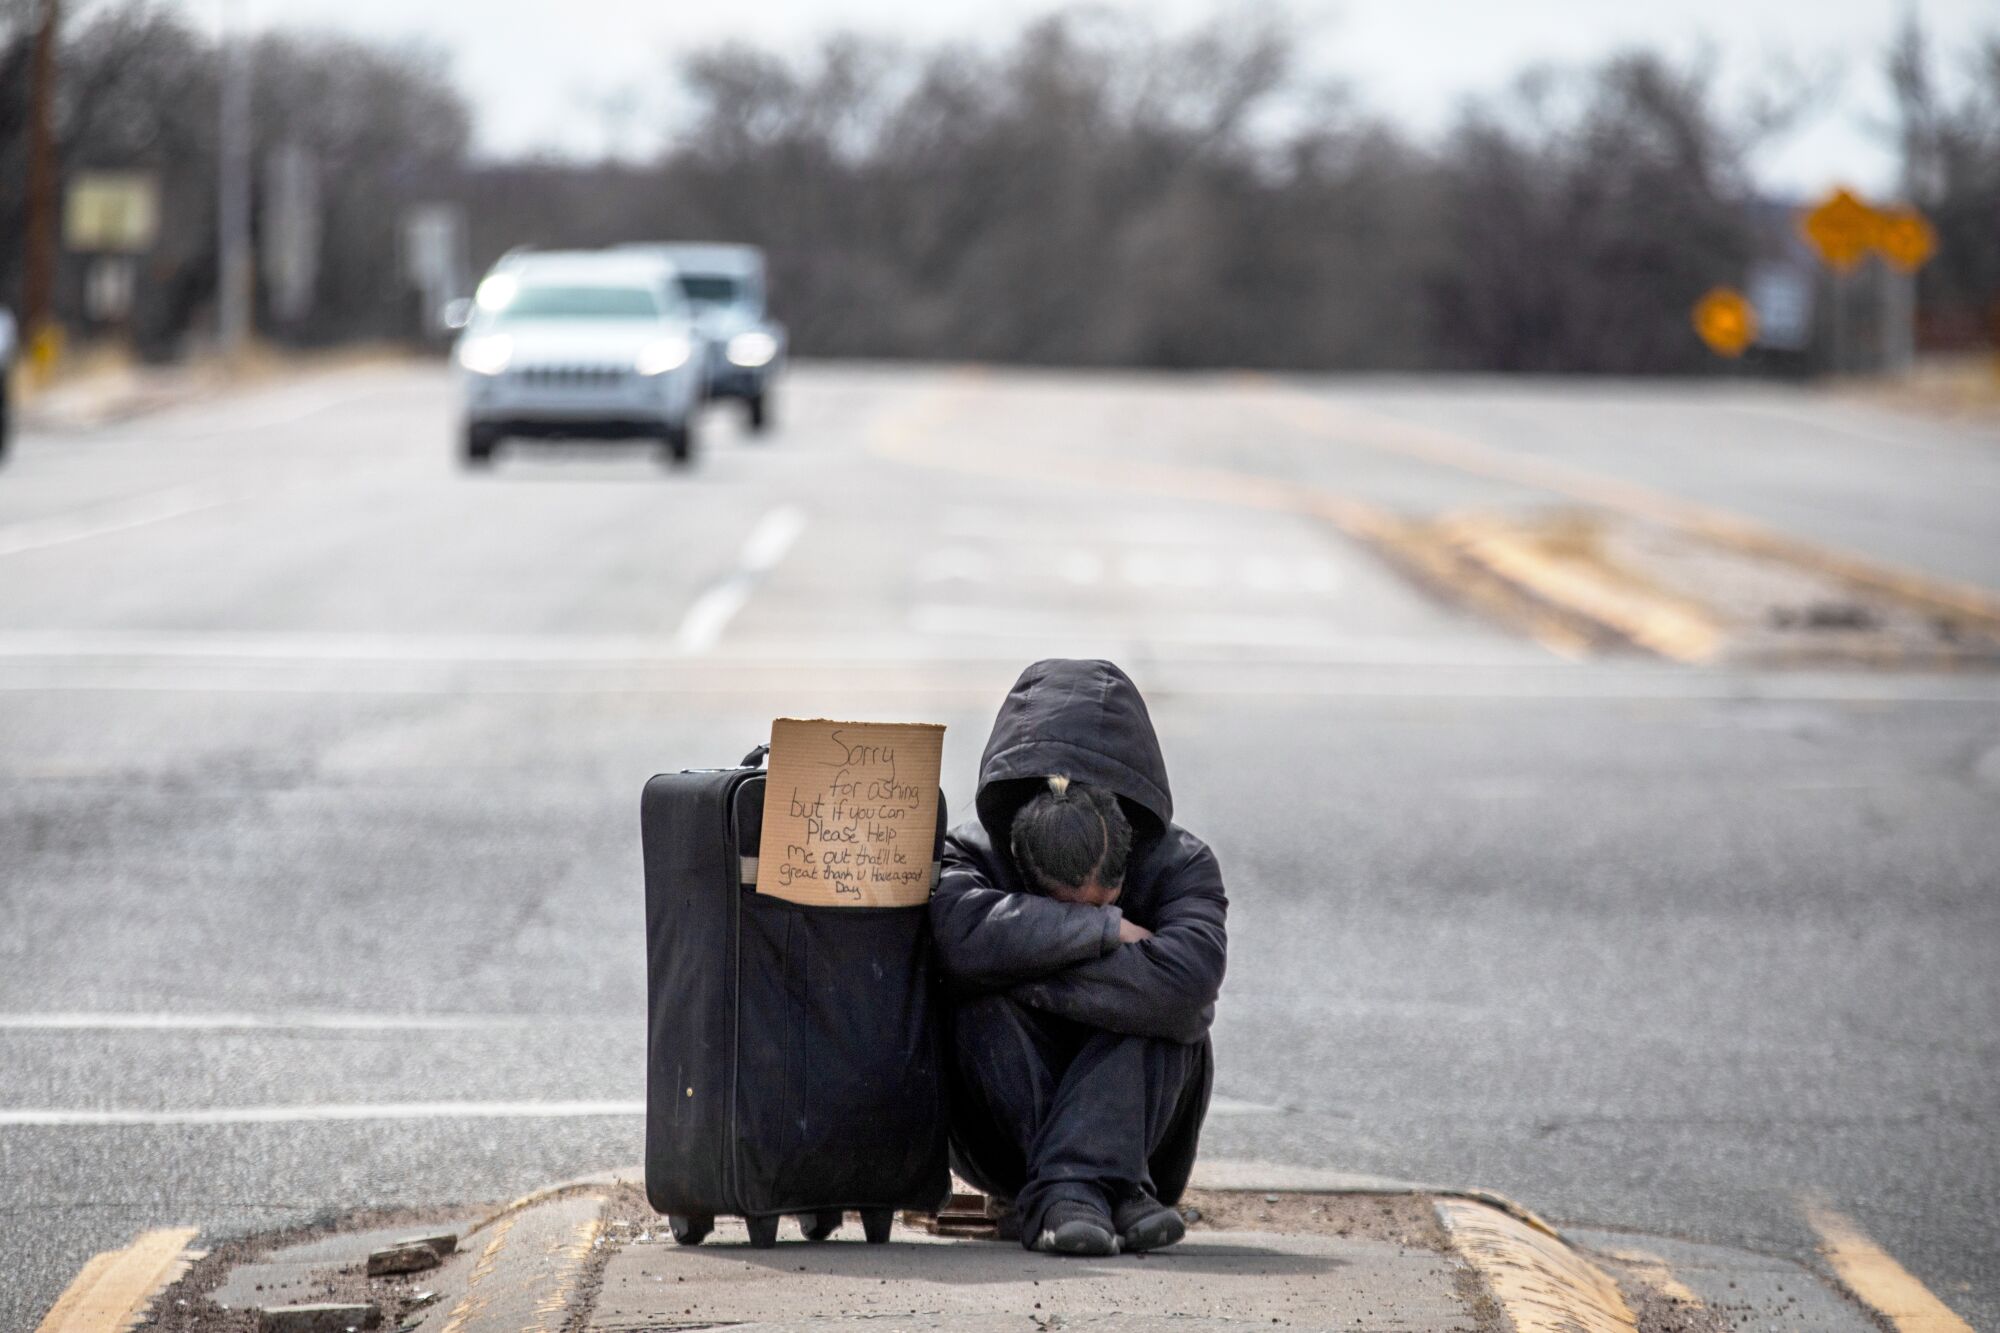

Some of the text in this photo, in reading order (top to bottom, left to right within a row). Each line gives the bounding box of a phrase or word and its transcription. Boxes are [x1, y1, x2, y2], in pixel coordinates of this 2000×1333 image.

[818, 730, 895, 782] Sorry
[830, 769, 920, 809] for asking
[790, 787, 824, 818] but
[832, 799, 847, 821] if
[850, 807, 874, 832] you
[807, 819, 897, 845] Please Help
[823, 848, 852, 865] out
[894, 845, 907, 865] be
[779, 863, 818, 886] great
[823, 865, 853, 880] thank
[901, 868, 922, 885] good
[835, 881, 862, 900] Day
